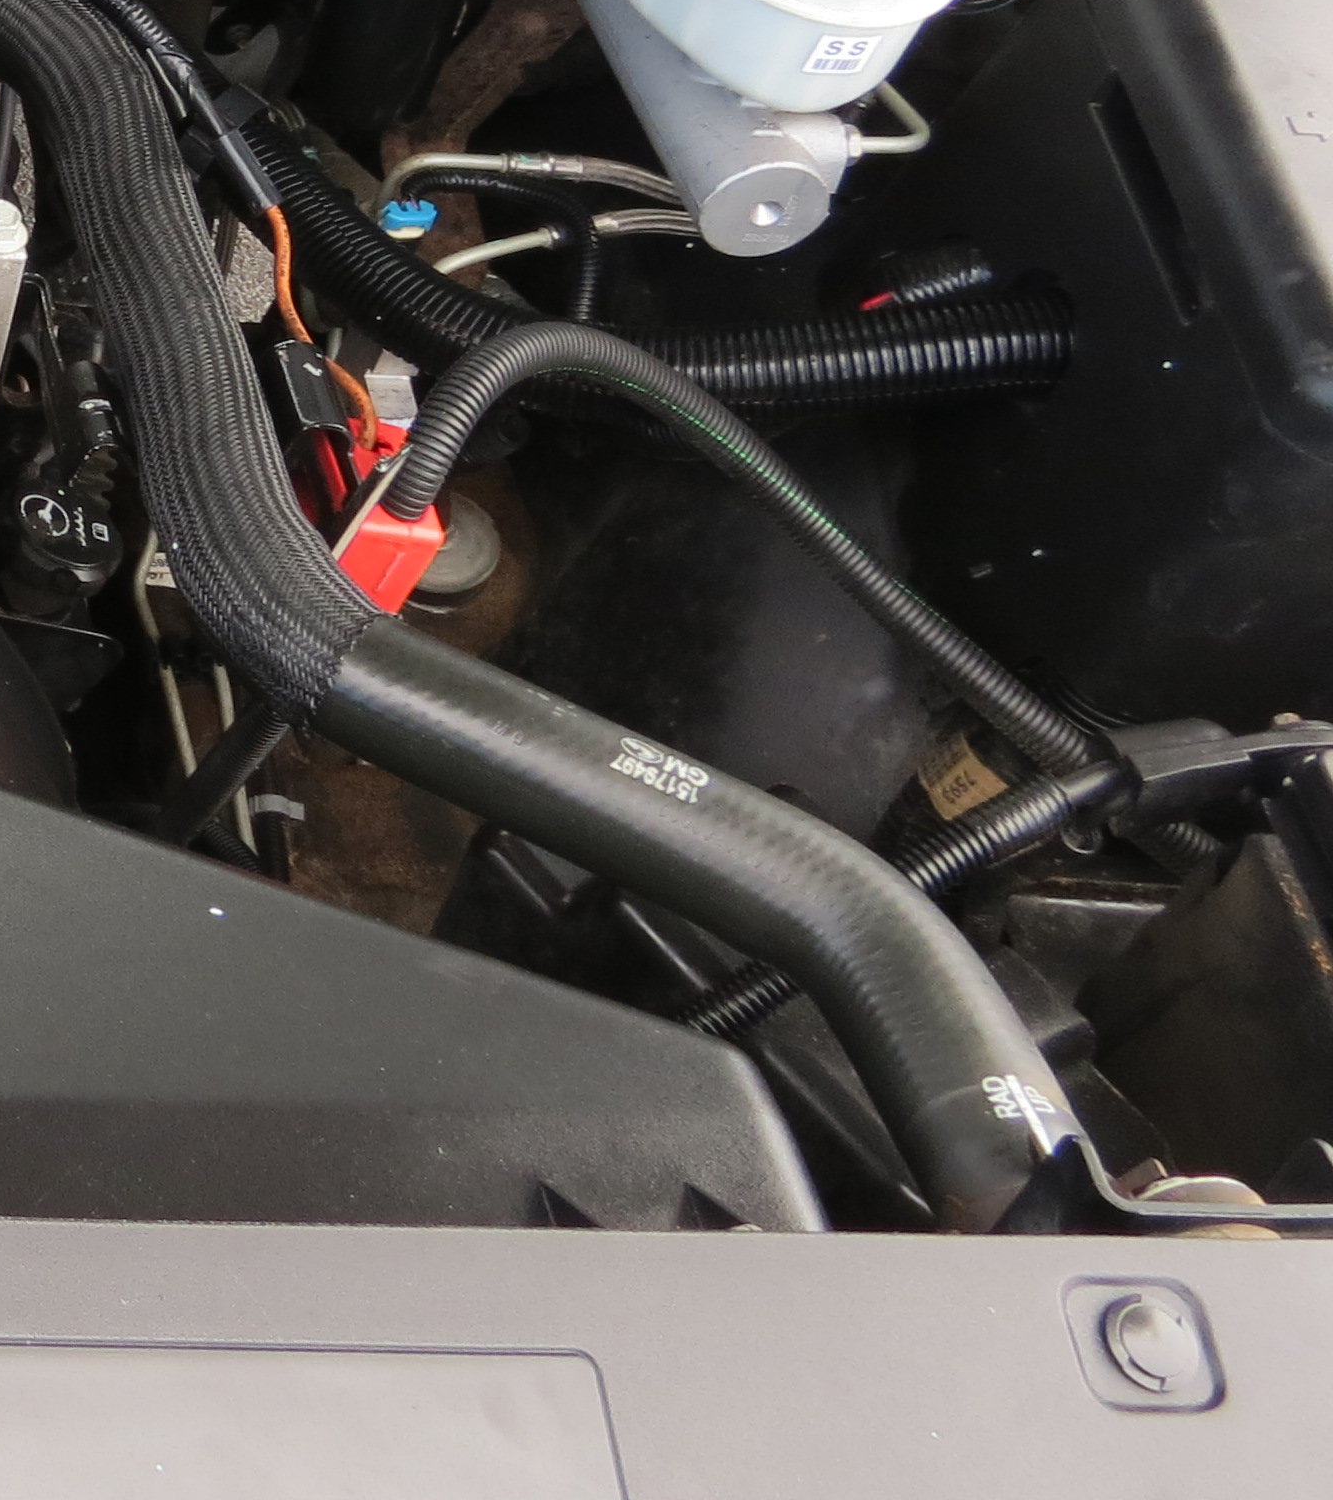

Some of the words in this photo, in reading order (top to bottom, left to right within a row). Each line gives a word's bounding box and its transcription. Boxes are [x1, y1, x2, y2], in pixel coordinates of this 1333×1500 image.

[663, 754, 710, 788] GM
[981, 1075, 1024, 1120] RAD
[1023, 1085, 1056, 1114] UP
